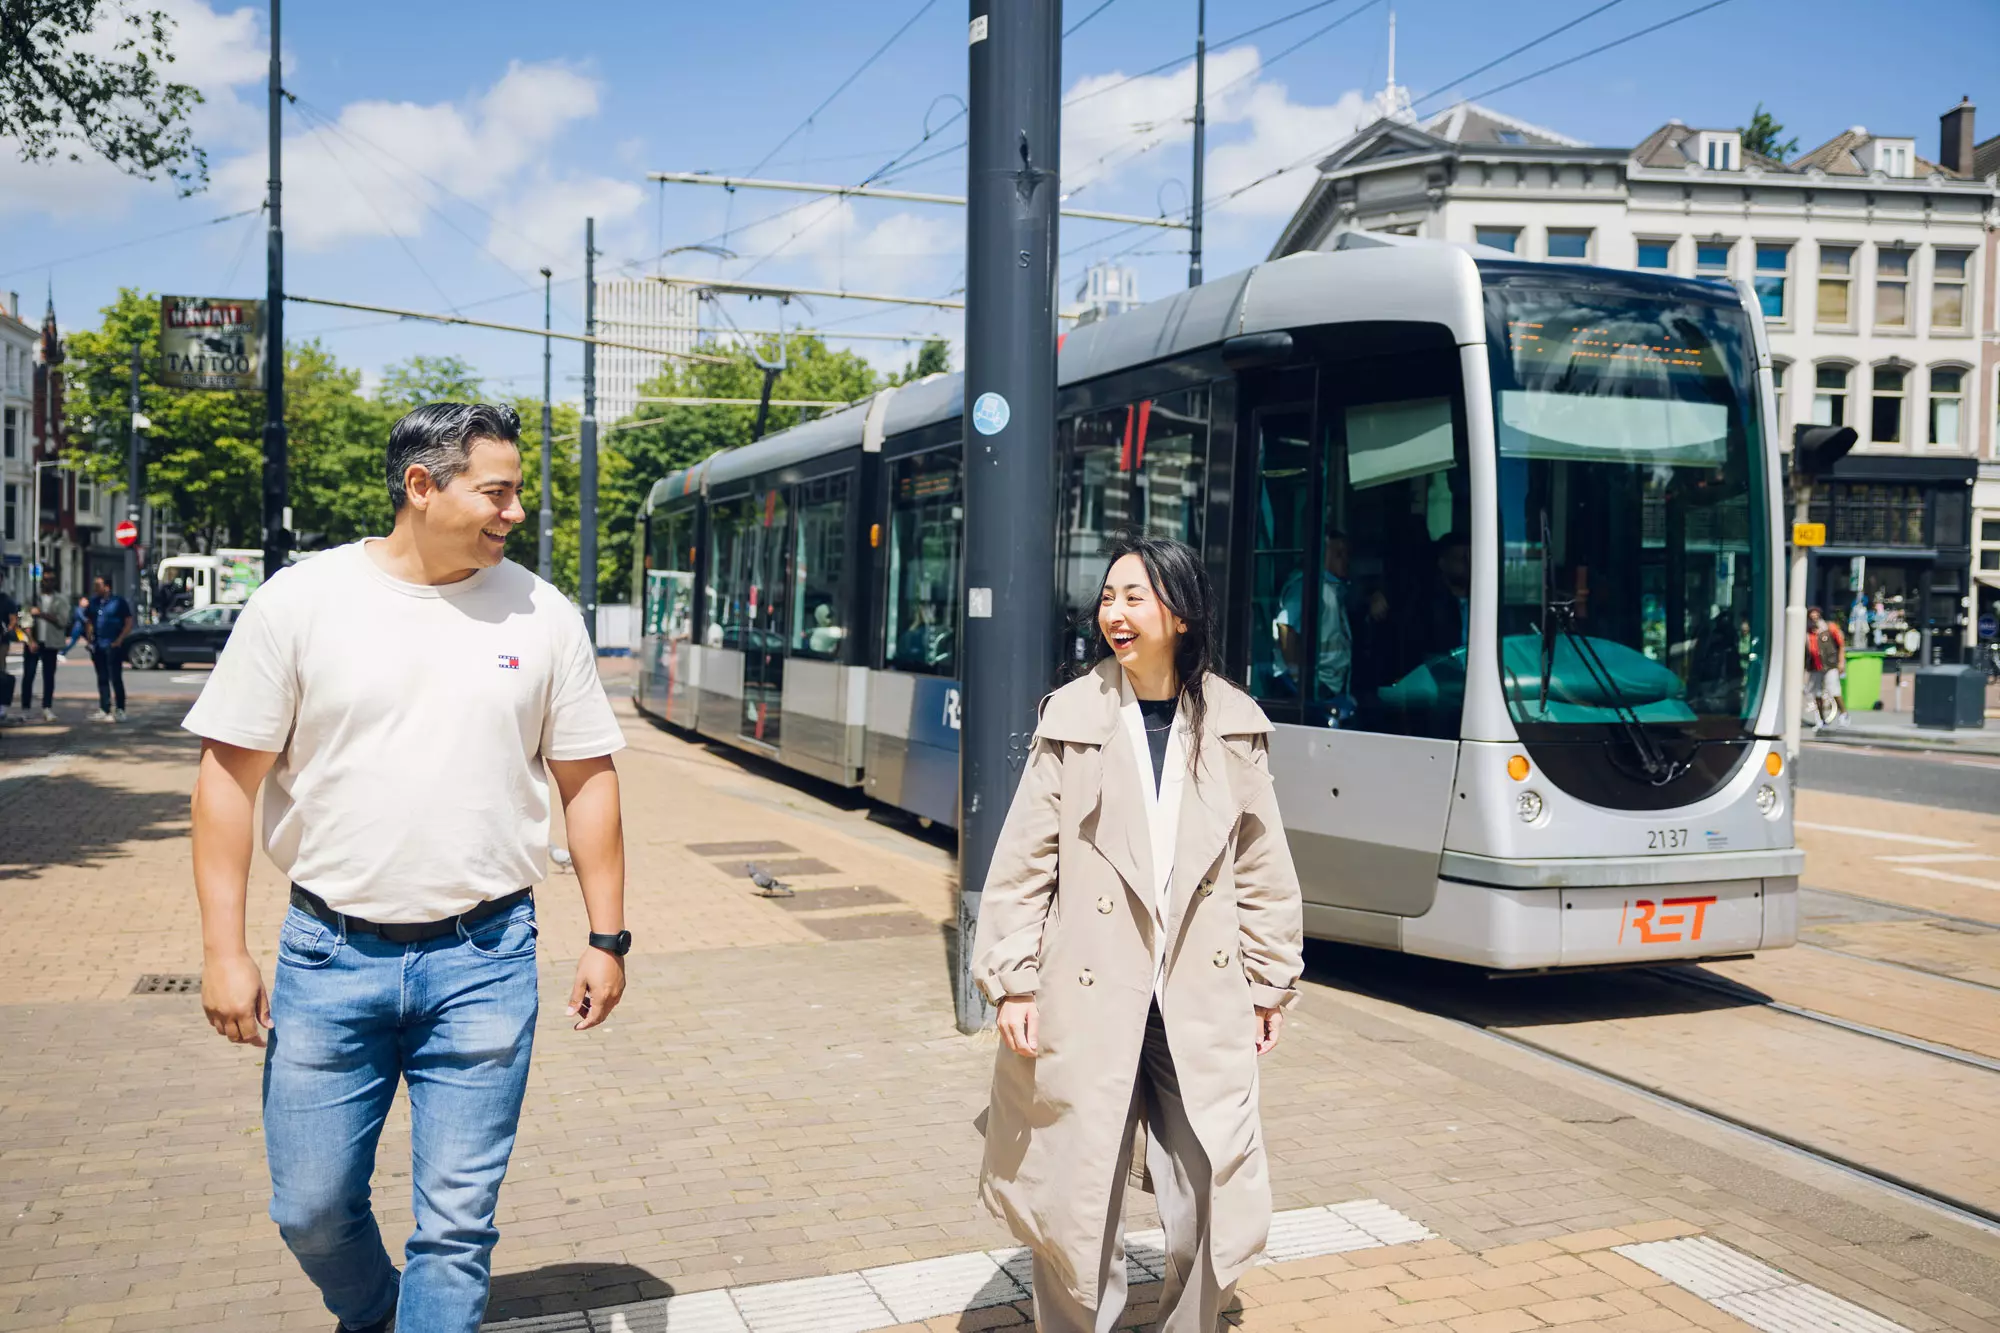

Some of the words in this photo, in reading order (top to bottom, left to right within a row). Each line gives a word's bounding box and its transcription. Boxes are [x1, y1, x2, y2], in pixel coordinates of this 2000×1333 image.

[167, 352, 249, 375] TATTOO
[1647, 828, 1688, 849] 2137
[1631, 895, 1718, 944] RET
